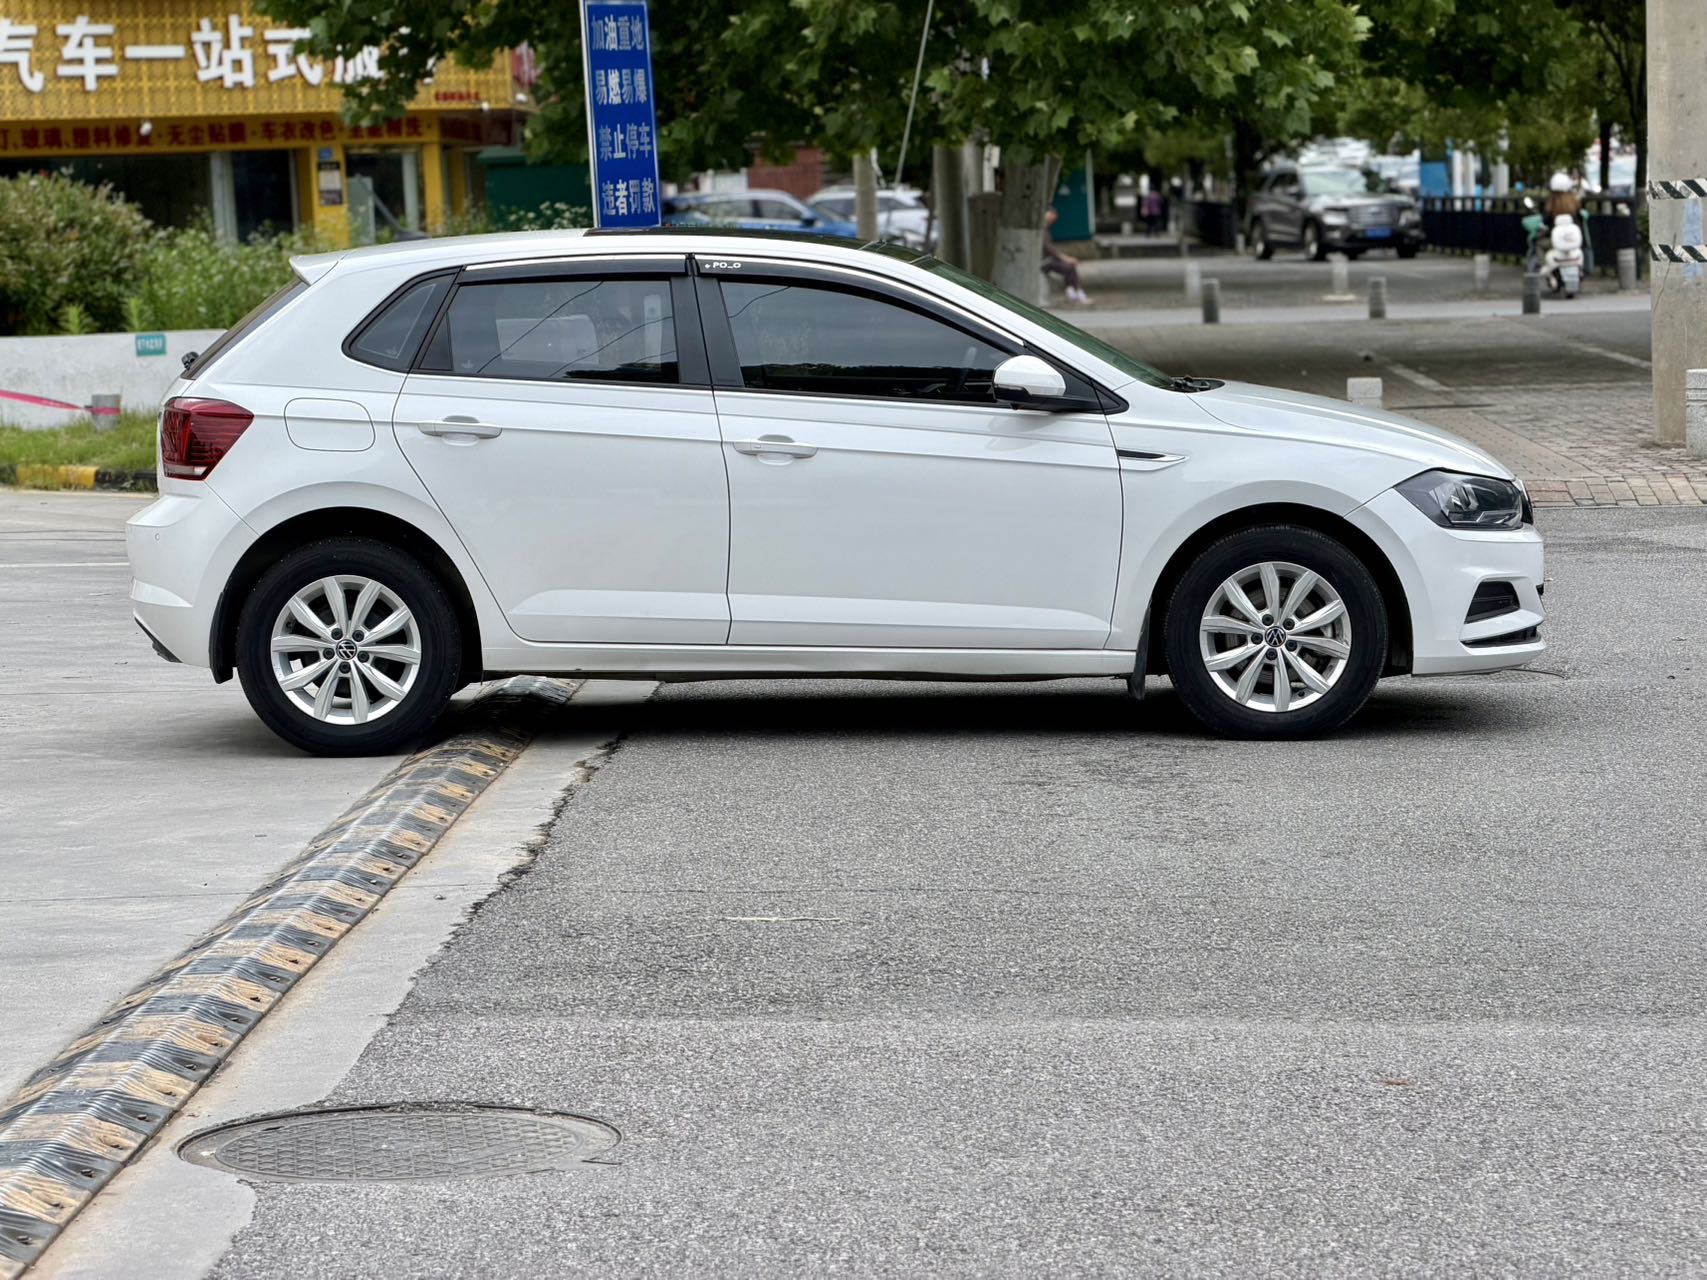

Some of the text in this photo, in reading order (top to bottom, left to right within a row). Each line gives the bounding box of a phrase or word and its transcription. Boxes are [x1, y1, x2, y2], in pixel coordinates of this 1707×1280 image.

[592, 14, 644, 51] 加油重地
[595, 68, 647, 105] 易燃易爆
[599, 122, 652, 161] 禁止停车
[602, 178, 655, 216] 违者罚款
